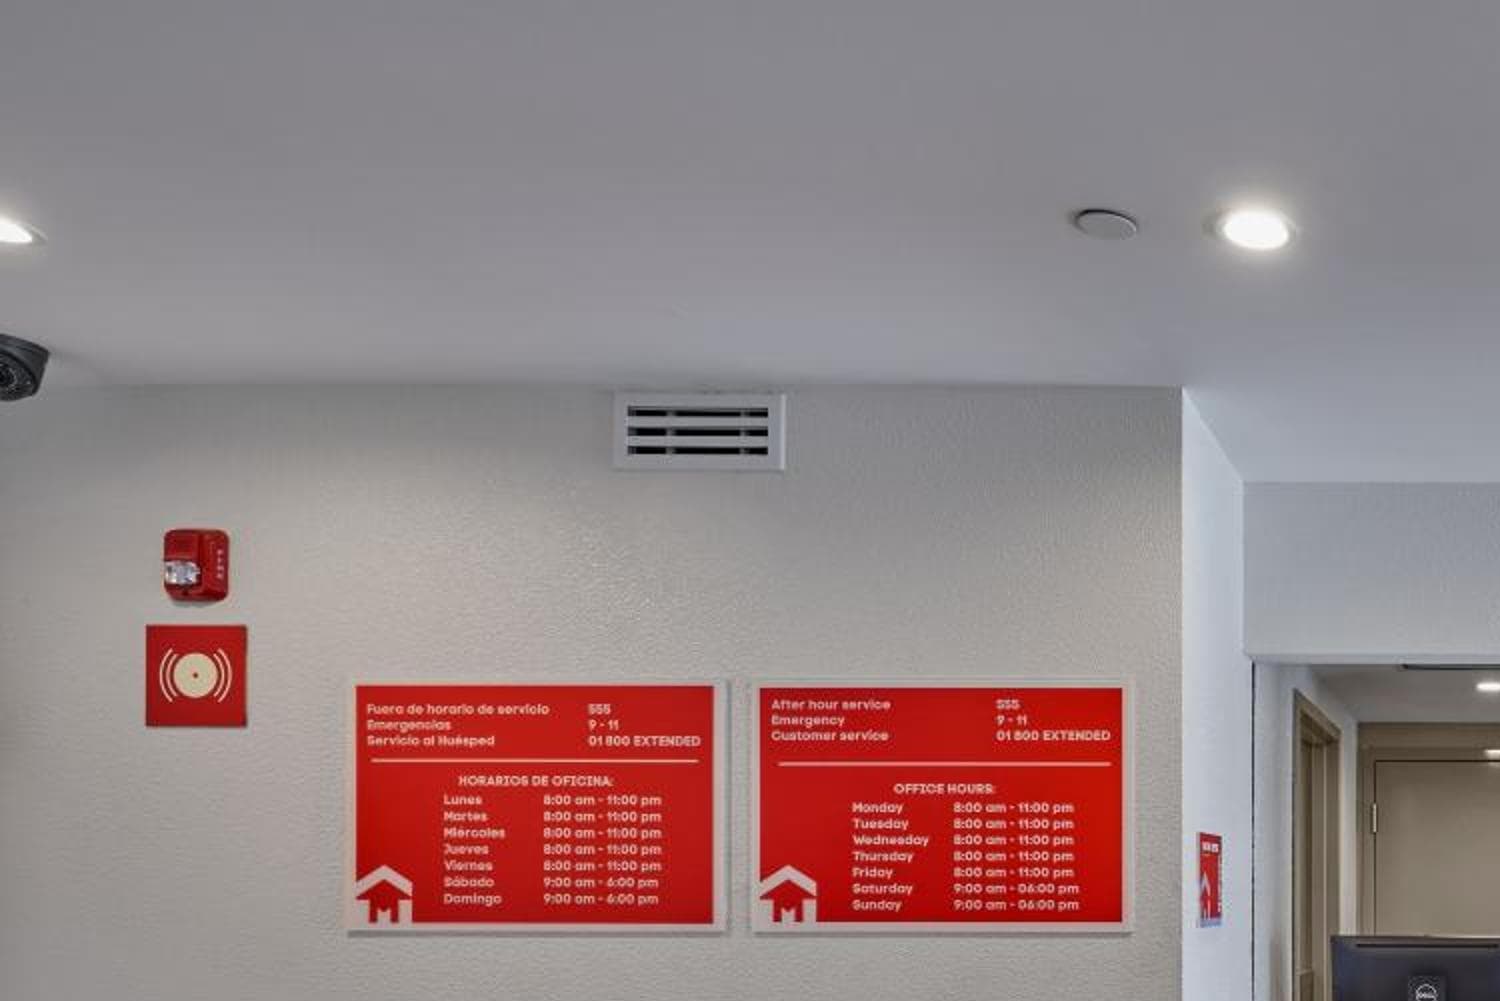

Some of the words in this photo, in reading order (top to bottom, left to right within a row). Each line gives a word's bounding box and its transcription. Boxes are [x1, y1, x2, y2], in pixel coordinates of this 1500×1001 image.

[366, 703, 405, 715] Fuera
[406, 703, 425, 715] de
[426, 703, 475, 715] horario
[476, 703, 495, 715] de
[497, 703, 551, 715] servicio
[587, 703, 612, 715] 555
[771, 699, 806, 711] After
[807, 699, 839, 711] hour
[841, 699, 892, 711] service
[366, 718, 452, 733] Emergencias
[607, 719, 620, 731] 11
[770, 714, 846, 729] Emergency
[1015, 714, 1028, 727] 11
[367, 734, 421, 747] Servicio
[422, 734, 435, 747] al
[587, 735, 603, 747] 01
[605, 735, 631, 747] 800
[633, 735, 702, 747] EXTENDED
[770, 730, 837, 742] Customer
[839, 729, 890, 742] service
[996, 729, 1012, 742] 01
[1013, 729, 1040, 742] 800
[1042, 729, 1111, 742] EXTENDED
[458, 775, 529, 787] HORARIOS
[531, 775, 549, 787] DE
[893, 783, 945, 795] OFFICE
[443, 794, 483, 806] Lunes
[543, 794, 572, 806] 8:00
[573, 796, 596, 806] am
[606, 794, 639, 806] 11:00
[640, 796, 662, 808] pm
[851, 801, 904, 815] Monday
[953, 801, 983, 813] 8:00
[985, 803, 1007, 813] am
[1018, 801, 1050, 813] 11:00
[1052, 803, 1075, 815] pm
[443, 810, 489, 822] Martes
[543, 810, 572, 823] 8:00
[573, 812, 596, 823] am
[606, 810, 639, 823] 11:00
[640, 812, 662, 824] pm
[852, 817, 909, 831] Tuesday
[953, 817, 983, 829] 8:00
[985, 819, 1007, 829] am
[1018, 817, 1050, 829] 11:00
[1052, 819, 1075, 831] pm
[543, 826, 572, 839] 8:00
[573, 829, 596, 839] am
[606, 827, 639, 839] 11:00
[640, 828, 662, 841] pm
[852, 834, 929, 847] Wednesday
[953, 834, 983, 846] 8:00
[985, 836, 1007, 846] am
[1018, 834, 1050, 846] 11:00
[1052, 836, 1075, 848] pm
[443, 842, 490, 855] Jueves
[543, 843, 572, 855] 8:00
[573, 845, 596, 855] am
[606, 843, 639, 855] 11:00
[640, 845, 662, 857] pm
[851, 850, 914, 863] Thursday
[953, 850, 983, 862] 8:00
[985, 852, 1007, 862] am
[1018, 850, 1050, 862] 11:00
[1052, 852, 1075, 864] pm
[443, 859, 494, 872] Viernes
[543, 859, 572, 872] 8:00
[573, 861, 596, 872] am
[606, 859, 639, 872] 11:00
[640, 862, 663, 873] pm
[851, 866, 894, 880] Friday
[953, 866, 983, 878] 8:00
[985, 868, 1007, 878] am
[1018, 866, 1050, 878] 11:00
[1052, 868, 1075, 880] pm
[543, 876, 572, 888] 9:00
[573, 878, 596, 888] am
[606, 876, 636, 888] 6:00
[637, 878, 659, 889] pm
[851, 882, 914, 896] Saturday
[953, 882, 983, 894] 9:00
[985, 884, 1007, 894] am
[1018, 882, 1056, 894] 06:00
[1057, 884, 1080, 896] pm
[443, 892, 503, 908] Domingo
[543, 892, 572, 905] 9:00
[573, 894, 596, 905] am
[606, 893, 636, 905] 6:00
[637, 895, 659, 907] pm
[851, 899, 903, 913] Sunday
[953, 899, 983, 911] 9:00
[985, 901, 1007, 911] am
[1018, 899, 1056, 911] 06:00
[1057, 901, 1080, 913] pm
